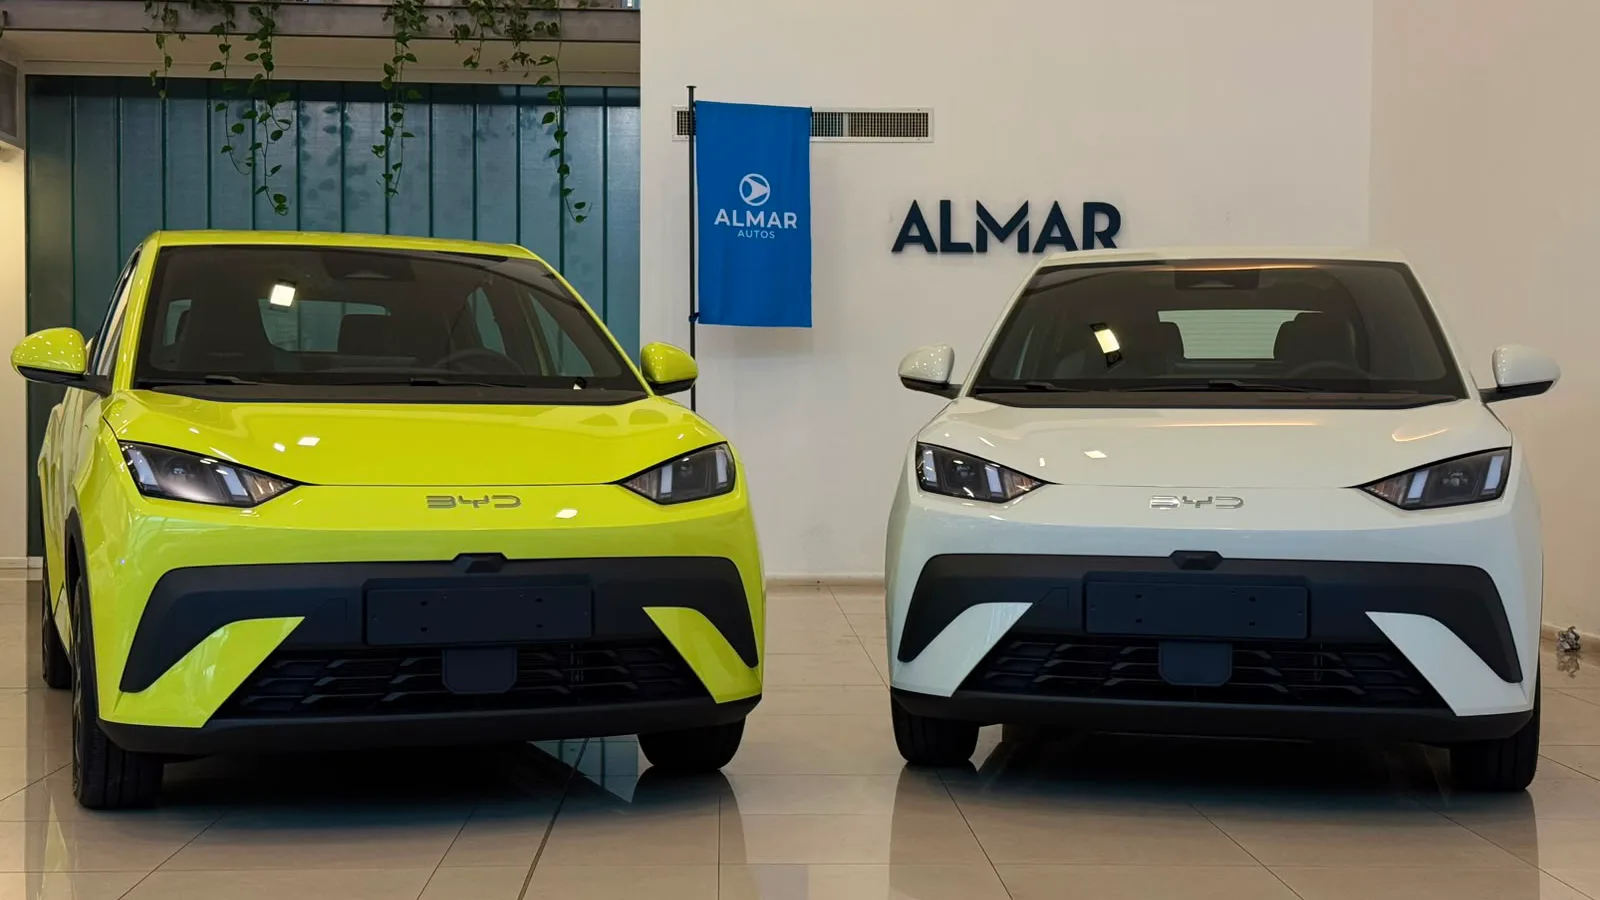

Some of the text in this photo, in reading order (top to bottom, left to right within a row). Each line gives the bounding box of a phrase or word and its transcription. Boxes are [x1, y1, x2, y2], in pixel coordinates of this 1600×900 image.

[714, 208, 798, 230] ALMAR
[891, 199, 1122, 253] ALMAR
[737, 229, 776, 239] AUTOS
[425, 494, 522, 509] BYD
[1149, 495, 1245, 510] BYD
